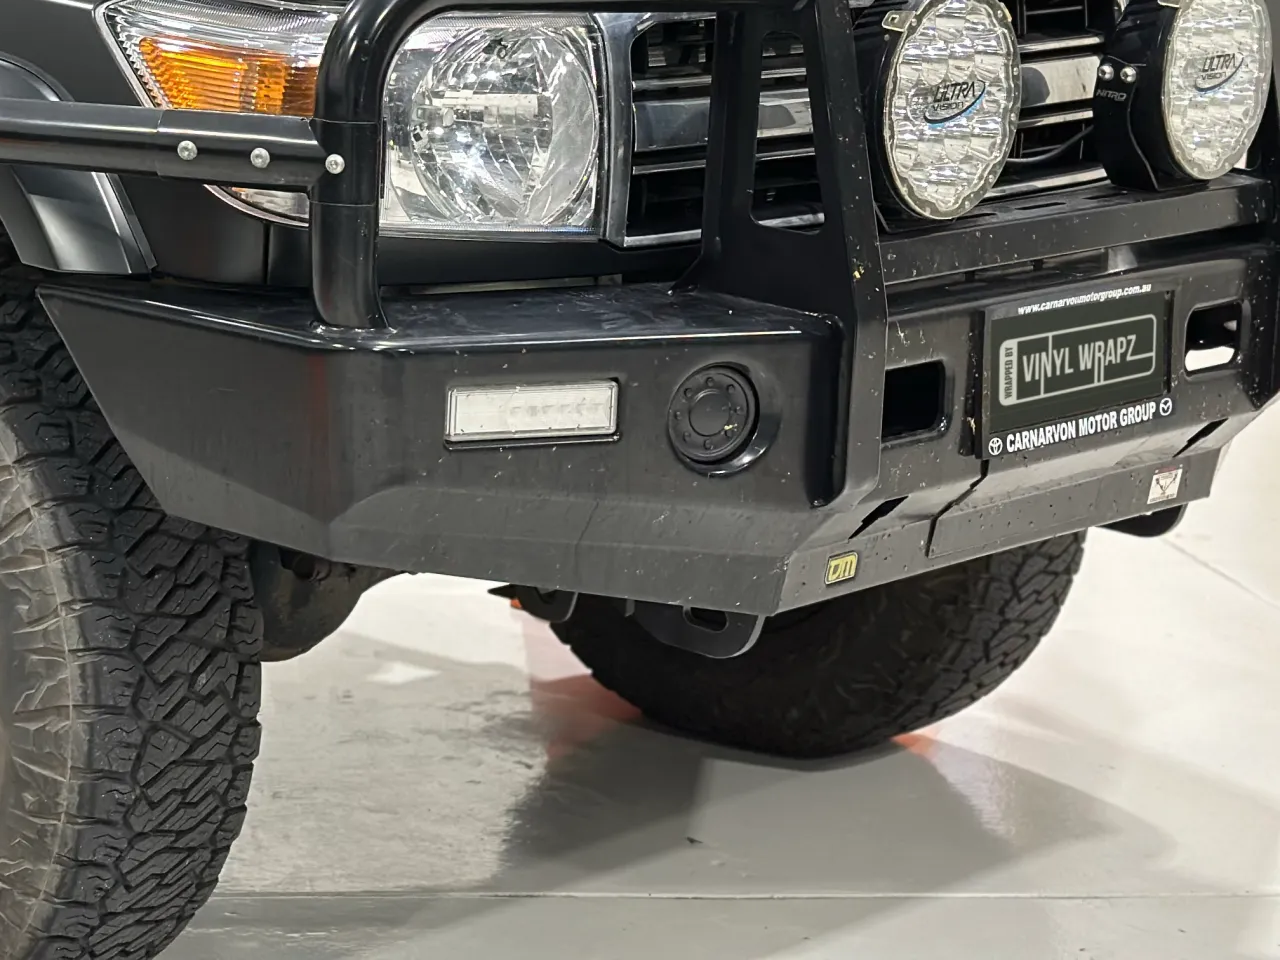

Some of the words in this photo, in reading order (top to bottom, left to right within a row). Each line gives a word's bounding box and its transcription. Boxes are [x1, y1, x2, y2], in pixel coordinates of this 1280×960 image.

[1202, 53, 1237, 72] ULTRA
[933, 81, 976, 103] ULTRA
[1096, 89, 1127, 102] NITRO
[1017, 283, 1152, 315] www.carnarvonmotorgroup.com.au
[1004, 347, 1014, 358] BY
[1022, 342, 1074, 390] VINYL
[1078, 334, 1138, 384] WRAPZ
[1004, 359, 1014, 400] WRAPPED
[1006, 420, 1076, 453] CARNARVON
[1078, 411, 1118, 438] MOTOR
[1120, 401, 1156, 427] GROUP
